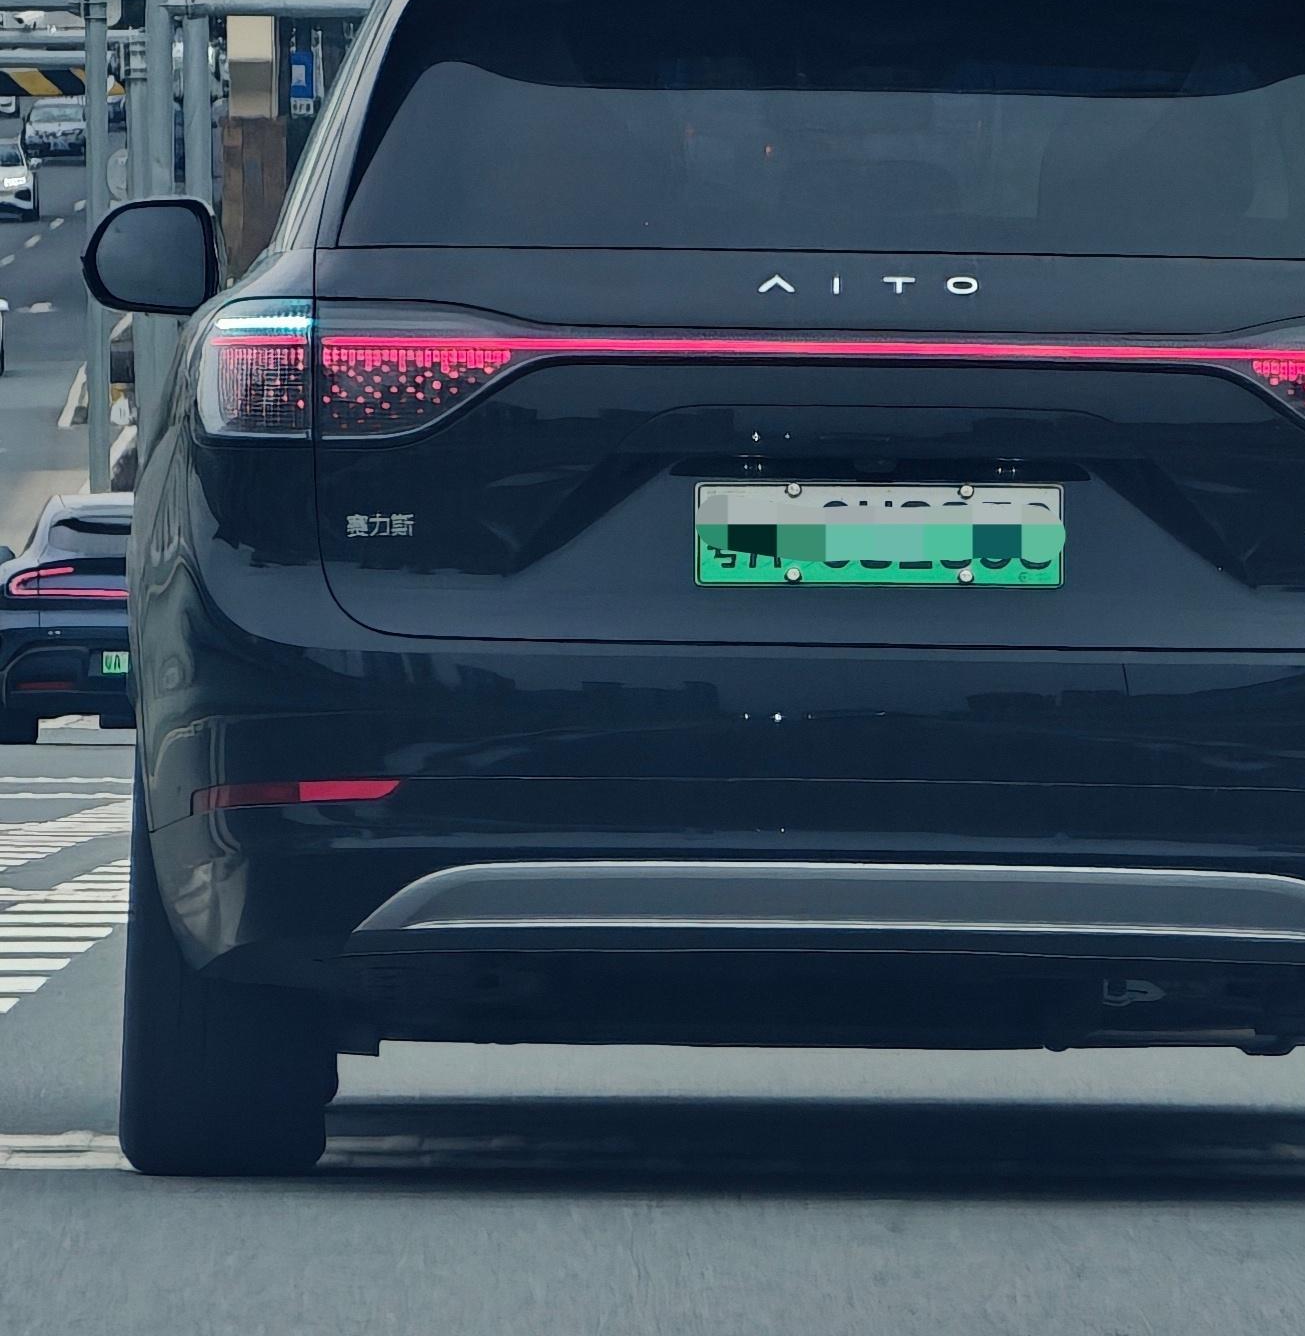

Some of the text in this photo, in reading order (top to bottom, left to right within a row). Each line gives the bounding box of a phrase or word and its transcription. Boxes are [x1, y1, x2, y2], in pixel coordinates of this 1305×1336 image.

[758, 274, 979, 295] AITO
[346, 513, 415, 538] 赛力斯
